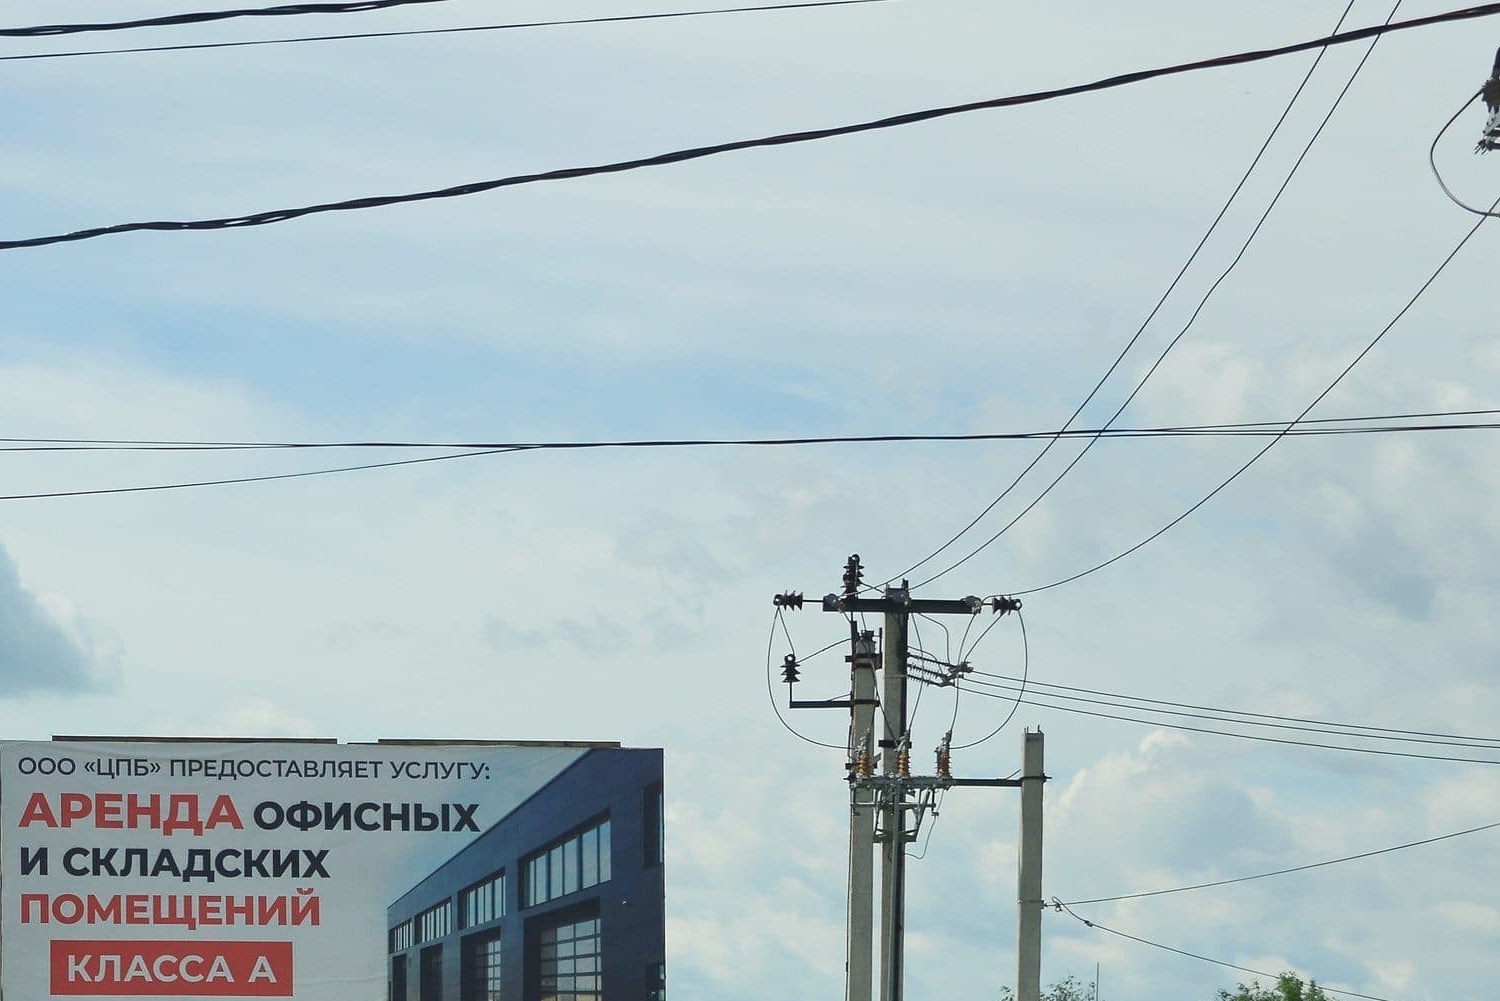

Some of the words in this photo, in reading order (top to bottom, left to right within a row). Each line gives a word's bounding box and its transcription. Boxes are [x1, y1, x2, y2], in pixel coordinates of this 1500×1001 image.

[18, 757, 76, 775] ООО
[84, 758, 161, 779] «ЦПБ»
[170, 759, 383, 780] ПРЕДОСТАВЛЯЕТ
[390, 761, 490, 780] УСЛУГУ:
[18, 792, 244, 836] АРЕНДА
[253, 801, 480, 832] ОФИСНЫХ
[20, 847, 48, 876] И
[62, 847, 331, 882] СКЛАДСКИХ
[20, 888, 320, 931] ПОМЕЩЕНИЙ
[67, 955, 235, 983] КЛАССА
[248, 956, 277, 983] А
